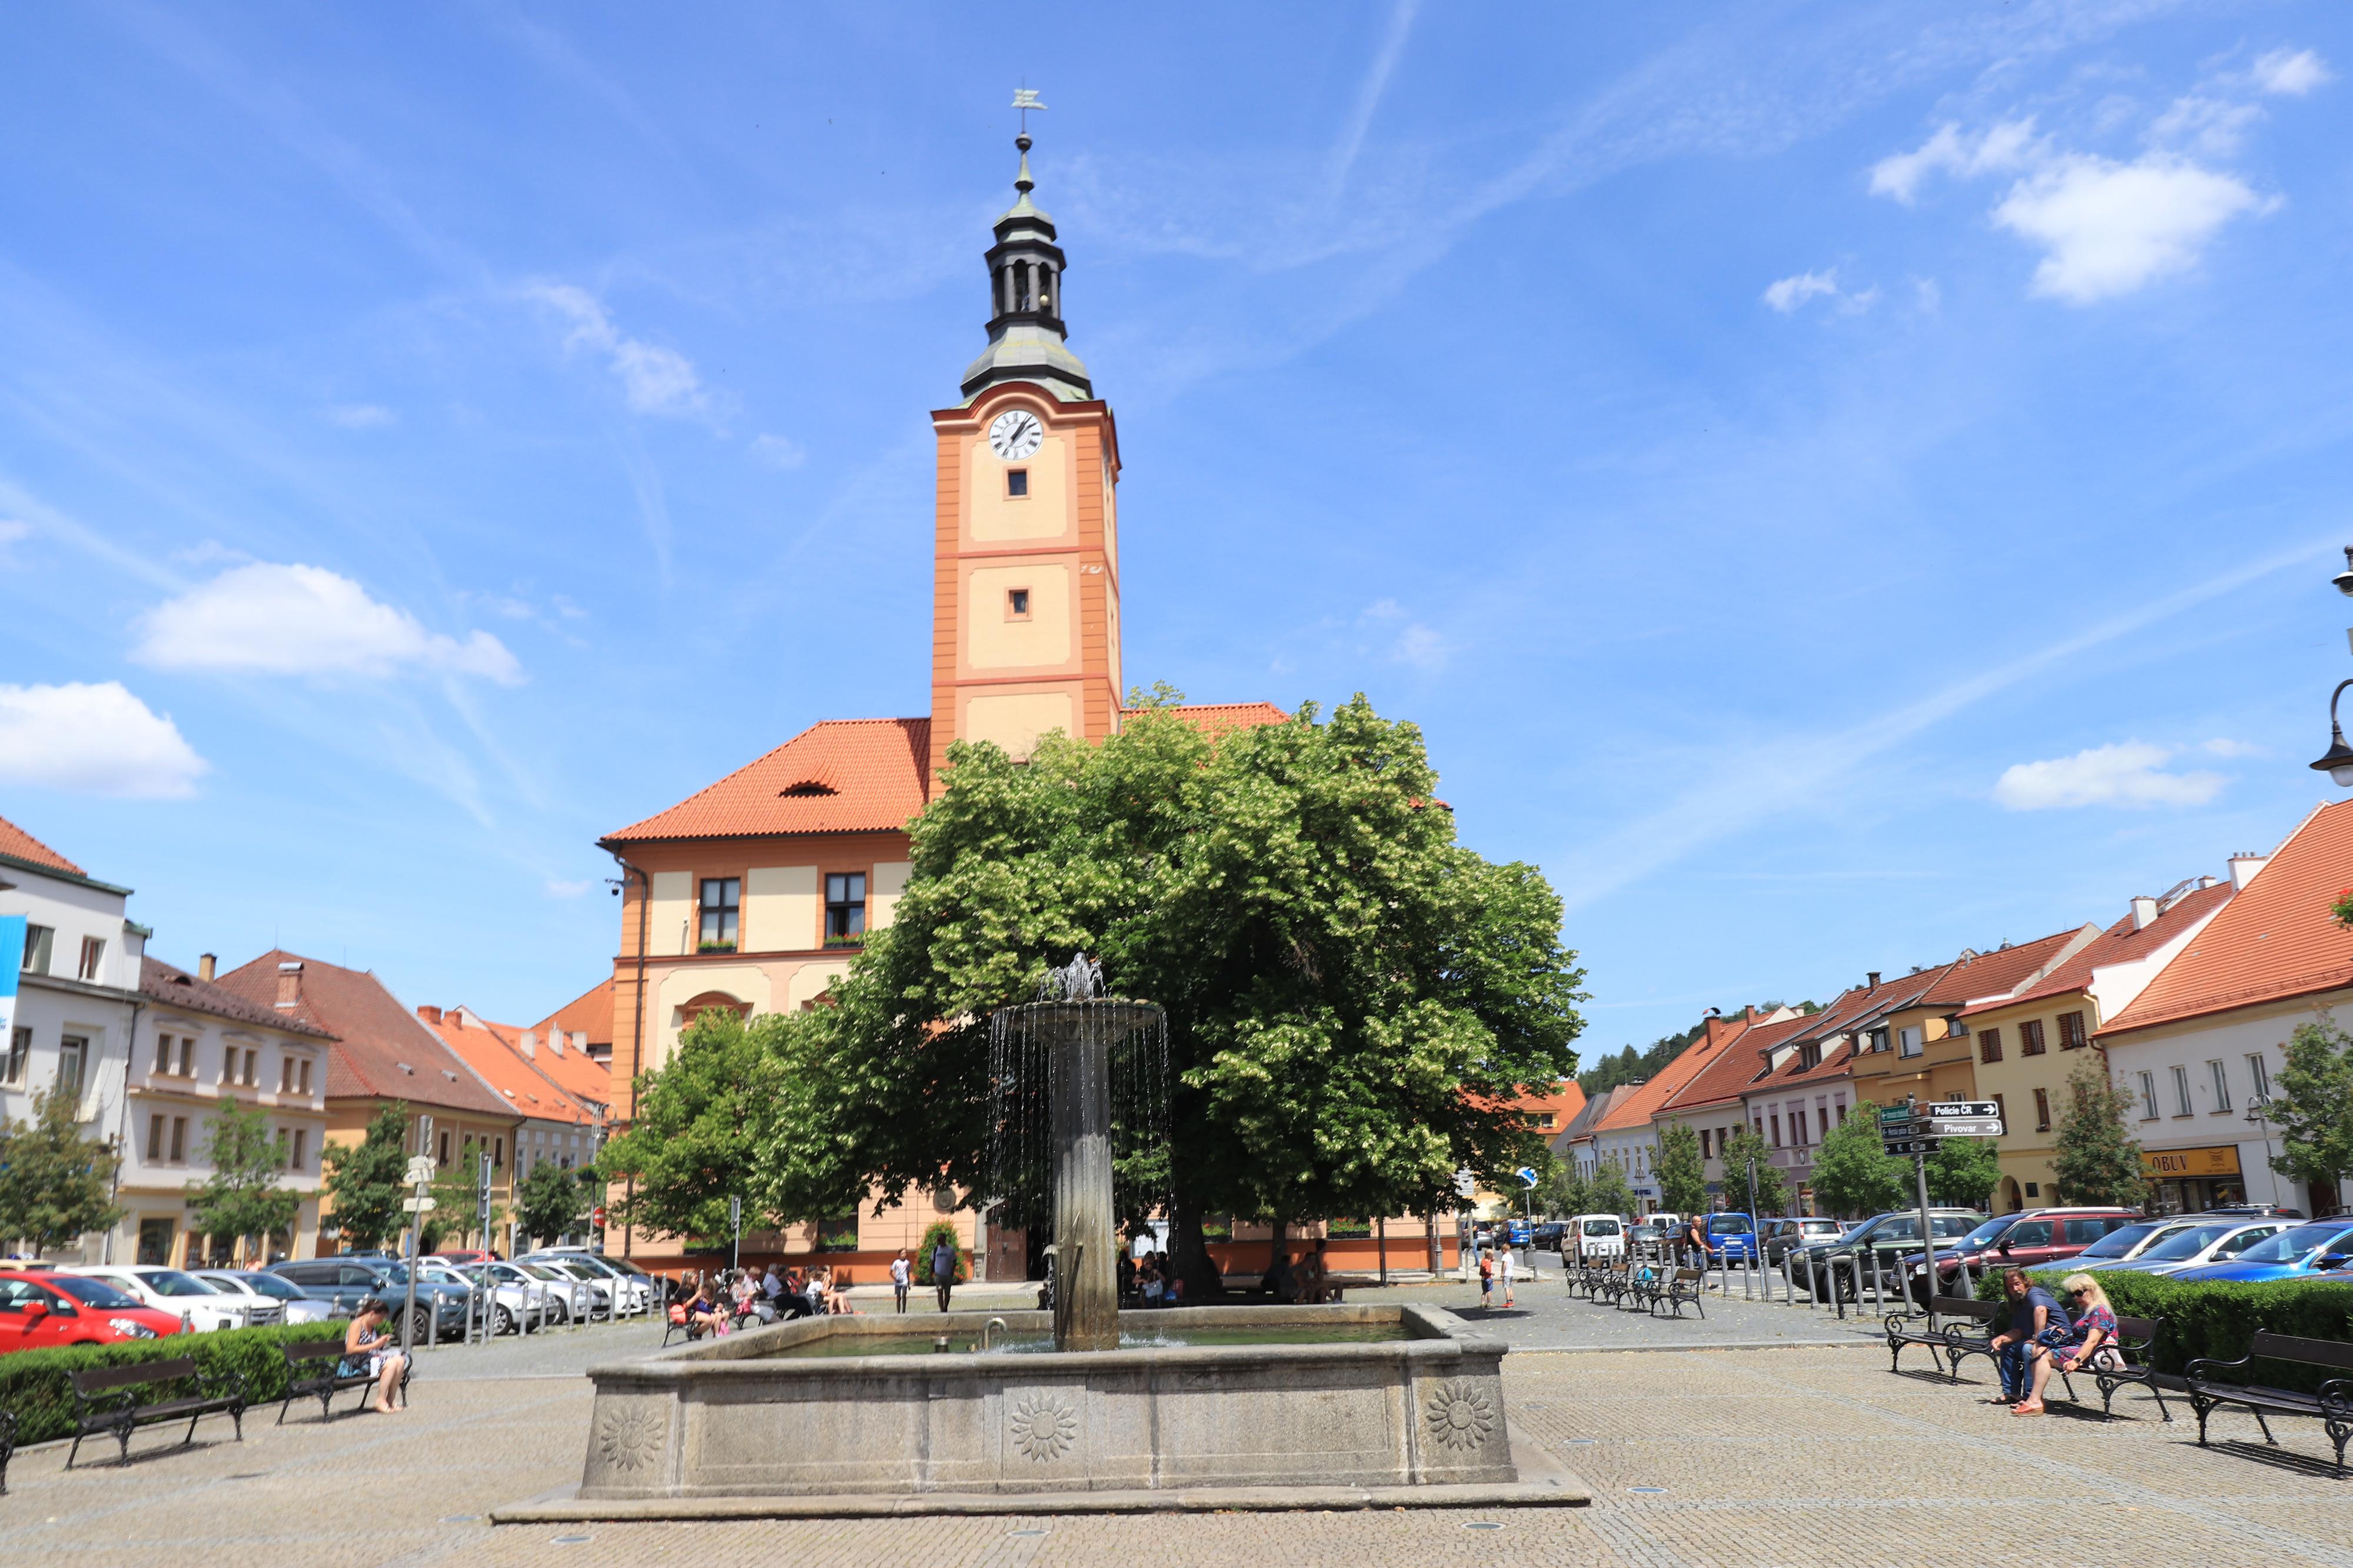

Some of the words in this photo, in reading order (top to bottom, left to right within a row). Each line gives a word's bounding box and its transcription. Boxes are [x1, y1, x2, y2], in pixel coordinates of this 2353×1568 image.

[1935, 1106, 1959, 1115] Policie
[1961, 1105, 1972, 1115] ČR
[1944, 1124, 1977, 1133] Pivovar
[2152, 1154, 2187, 1172] OBUV
